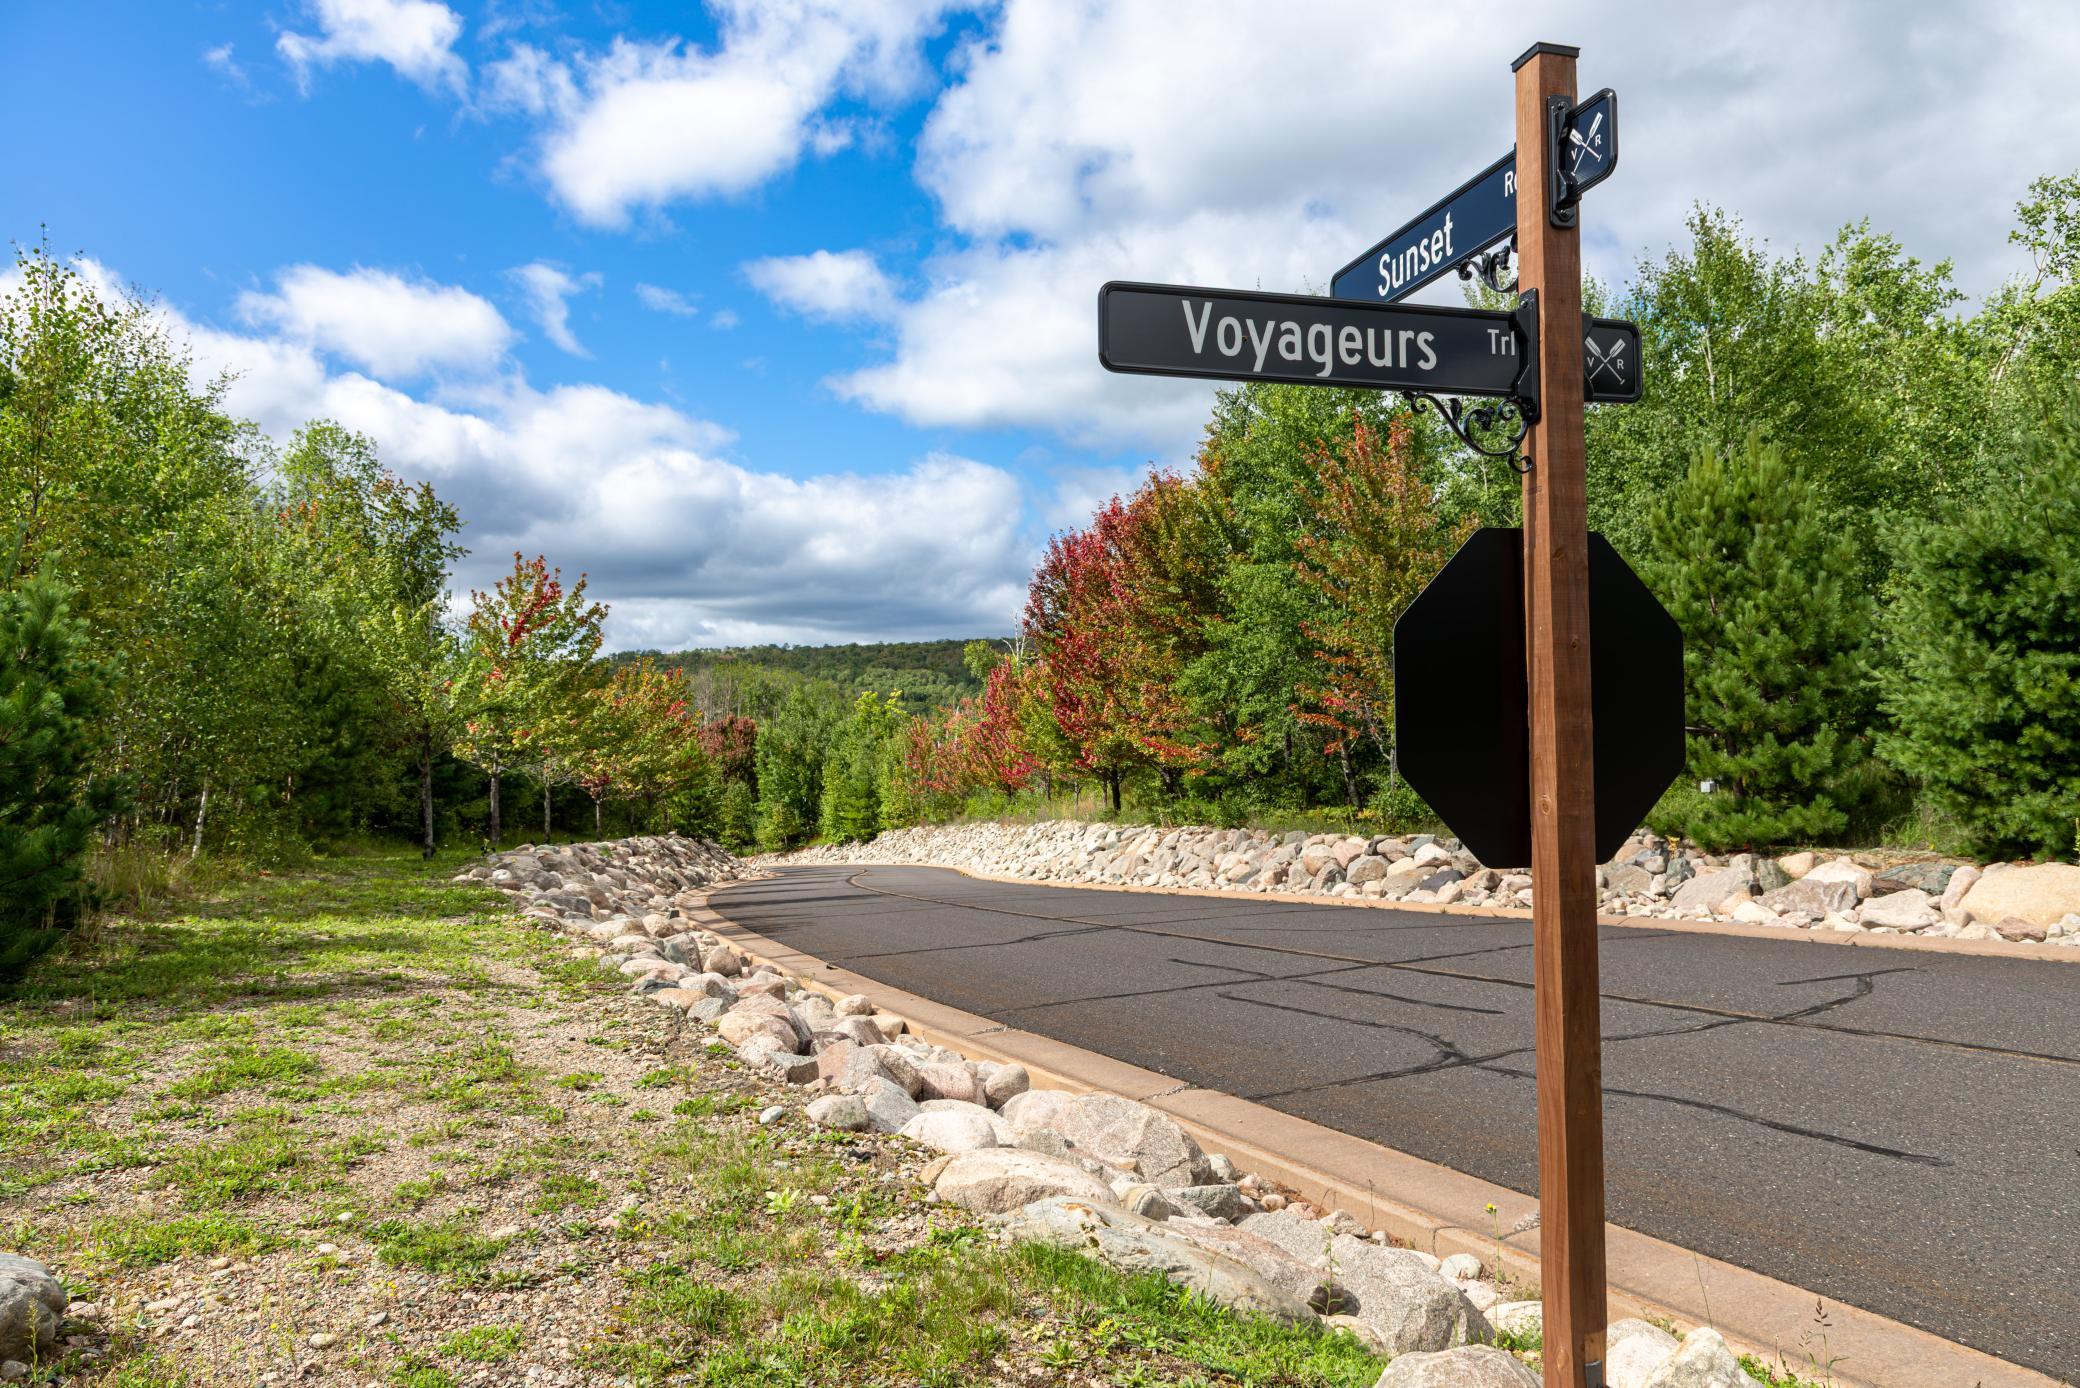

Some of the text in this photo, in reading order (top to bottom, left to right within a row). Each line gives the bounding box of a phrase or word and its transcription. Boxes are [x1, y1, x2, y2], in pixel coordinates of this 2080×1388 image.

[1571, 134, 1602, 160] V R
[1378, 211, 1454, 297] Sunset
[1181, 299, 1516, 378] Voyageurs Trl
[1587, 356, 1624, 370] V R
